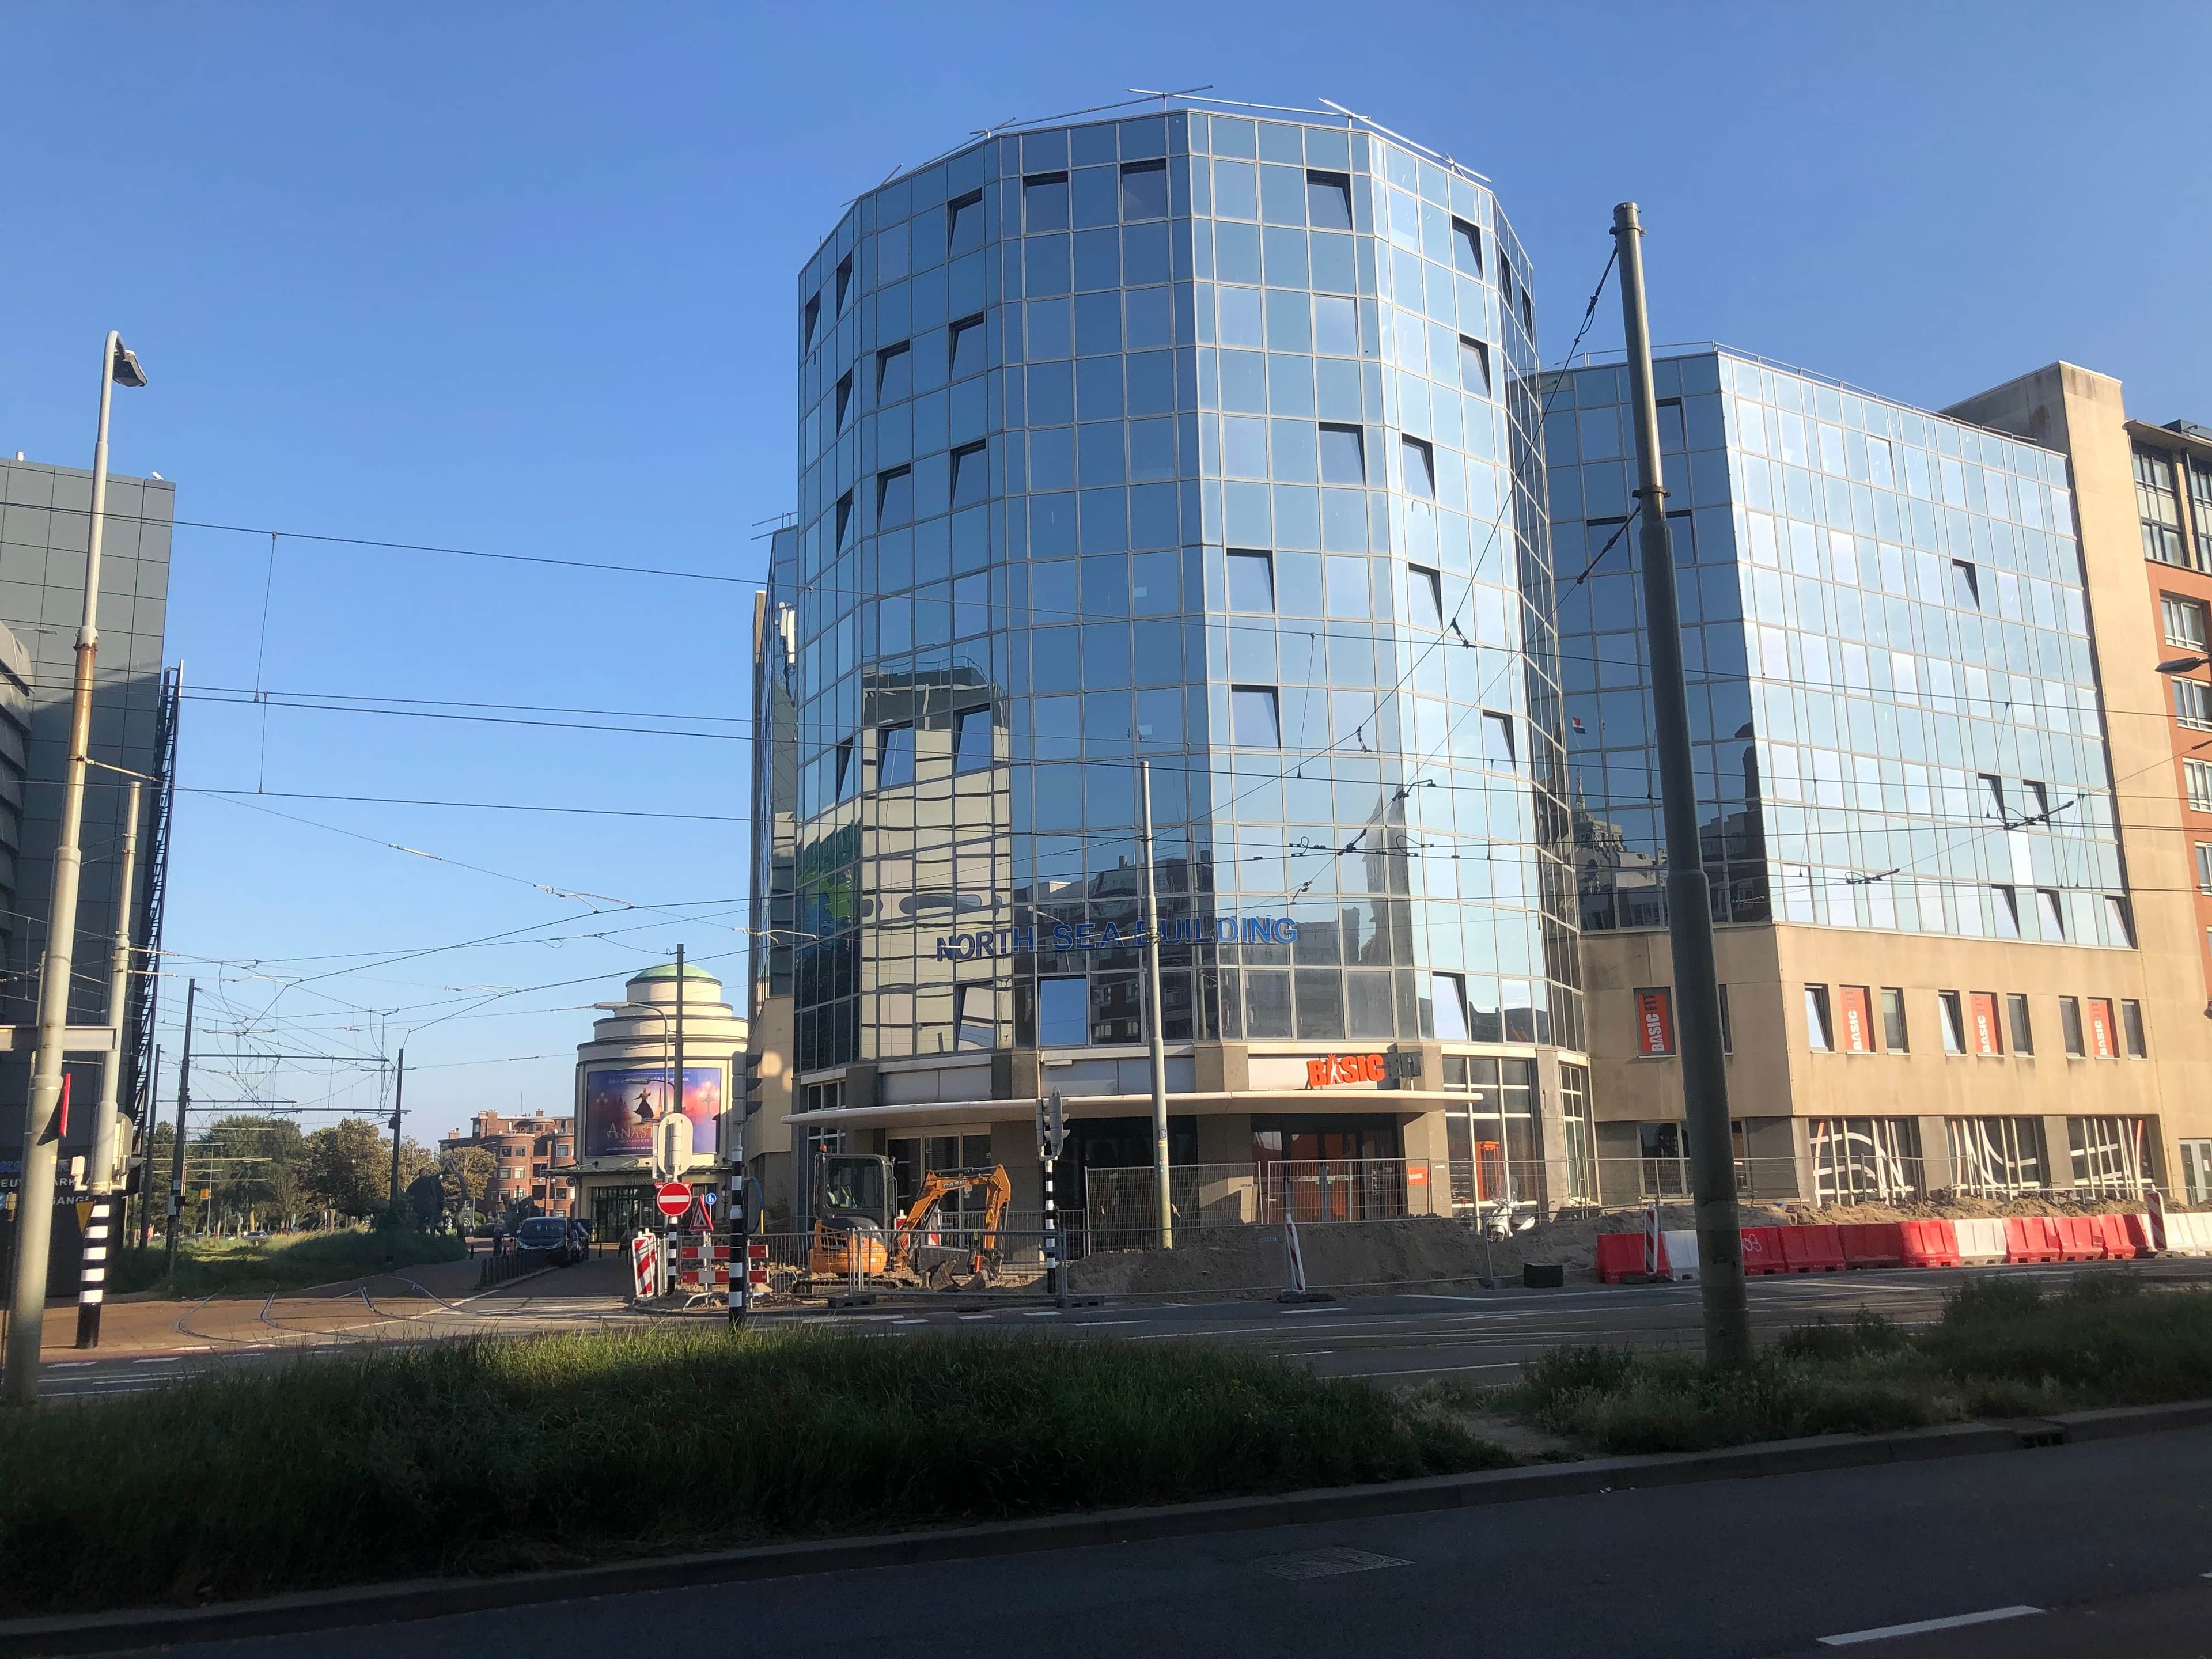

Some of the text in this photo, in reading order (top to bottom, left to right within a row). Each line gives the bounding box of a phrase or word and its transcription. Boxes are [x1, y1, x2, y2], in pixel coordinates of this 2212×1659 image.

[937, 925, 1034, 961] NORTH
[1052, 922, 1124, 950] SEA
[1646, 1013, 1665, 1051] BASIC
[1848, 1010, 1863, 1050] BASIC
[1977, 1015, 1991, 1052] BASIC
[2094, 1020, 2108, 1056] BASIC
[1306, 1053, 1385, 1086] BASIC
[606, 1122, 653, 1139] ANAST
[943, 1180, 965, 1188] CASE
